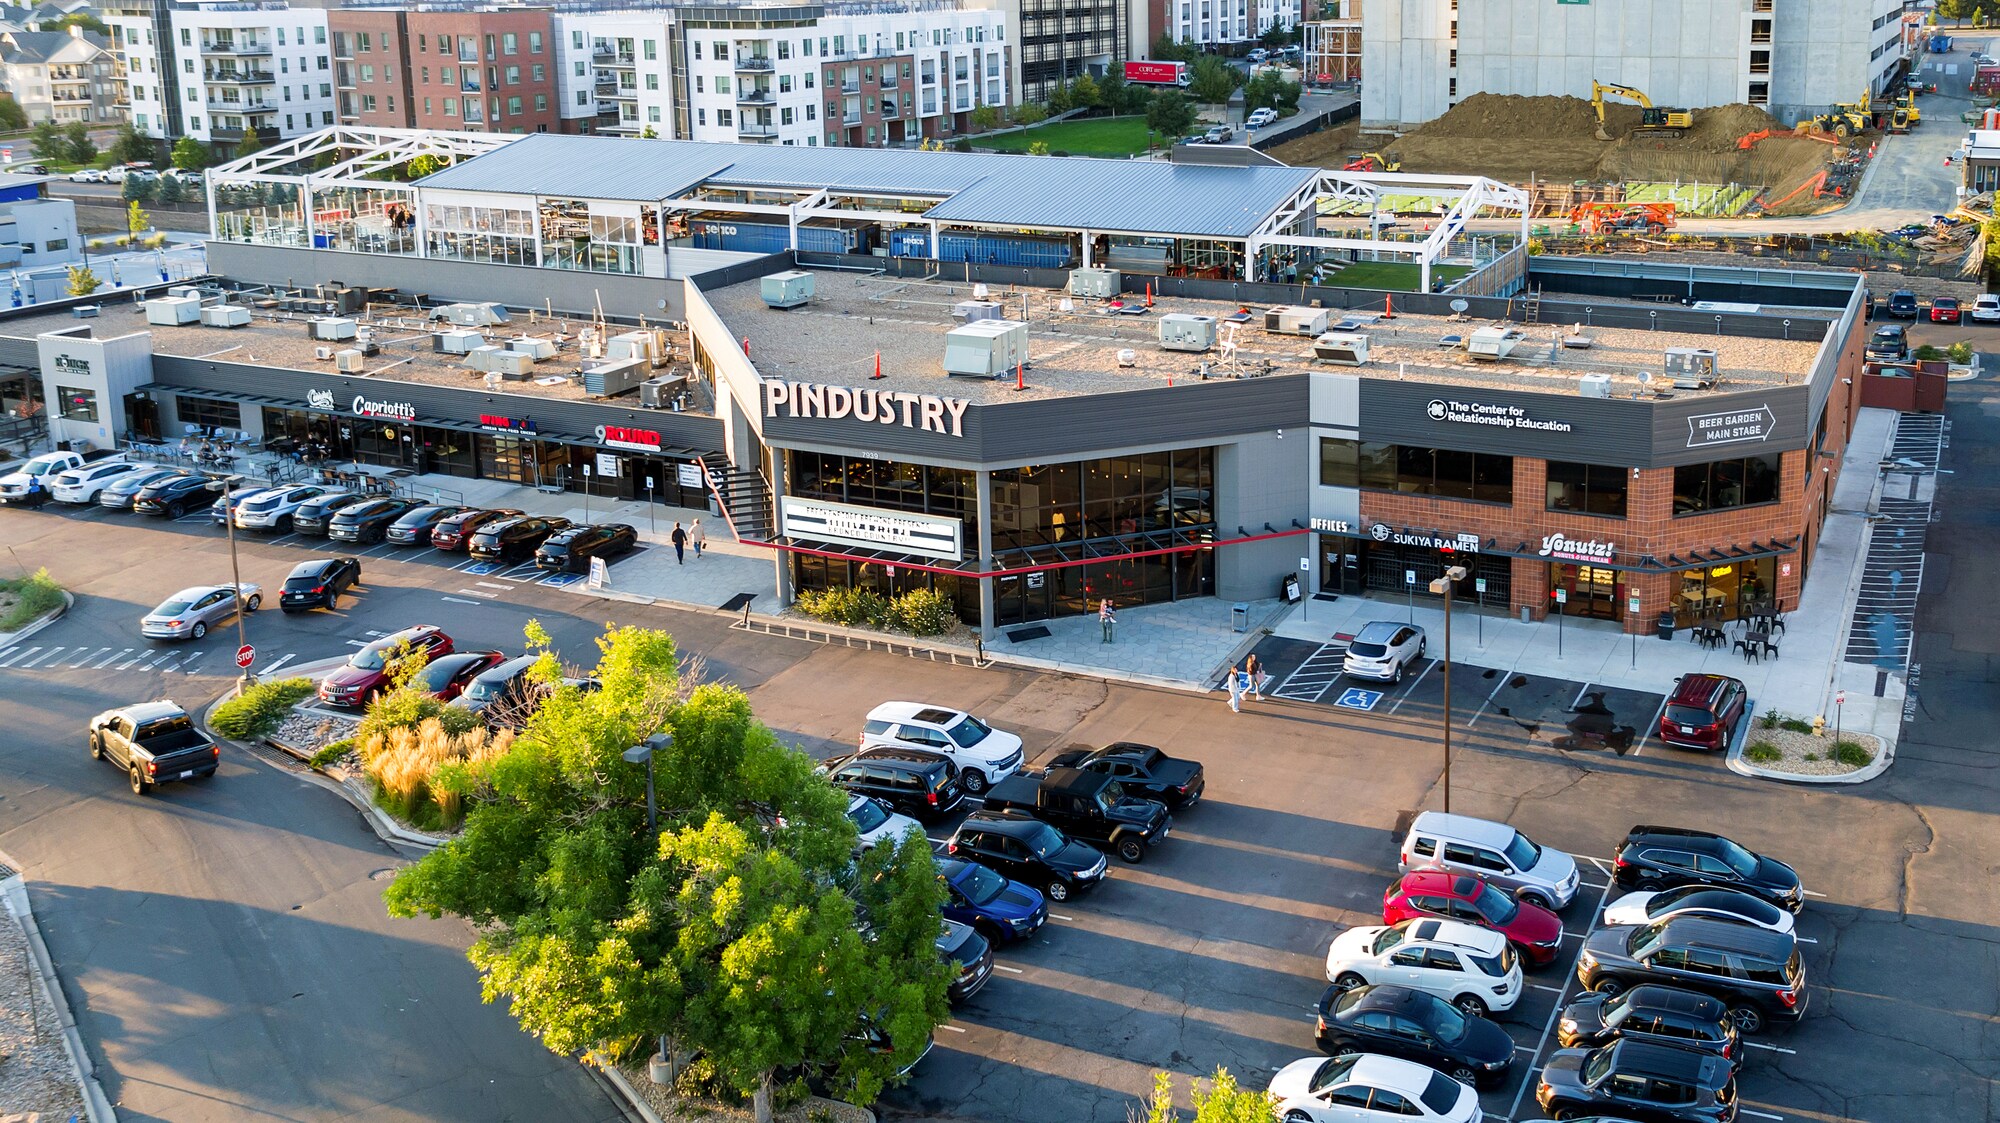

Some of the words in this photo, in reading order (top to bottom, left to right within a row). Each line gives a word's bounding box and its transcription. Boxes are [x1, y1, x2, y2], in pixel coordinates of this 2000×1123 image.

[353, 395, 416, 417] Capriotti's
[767, 379, 971, 437] PINDUSTRY
[1448, 401, 1469, 412] The
[1471, 403, 1508, 415] Center
[1508, 406, 1525, 417] for
[1447, 412, 1515, 428] Relationship
[1515, 418, 1571, 432] Education
[1699, 418, 1722, 429] BEER
[1725, 412, 1762, 425] GARDEN
[1706, 429, 1730, 440] MAIN
[1732, 425, 1761, 437] STAGE
[862, 451, 879, 459] 7939
[1311, 518, 1347, 532] OFFICES
[1393, 534, 1432, 547] SUKIYA
[1434, 538, 1479, 552] RAMEN
[237, 650, 254, 662] STOP
